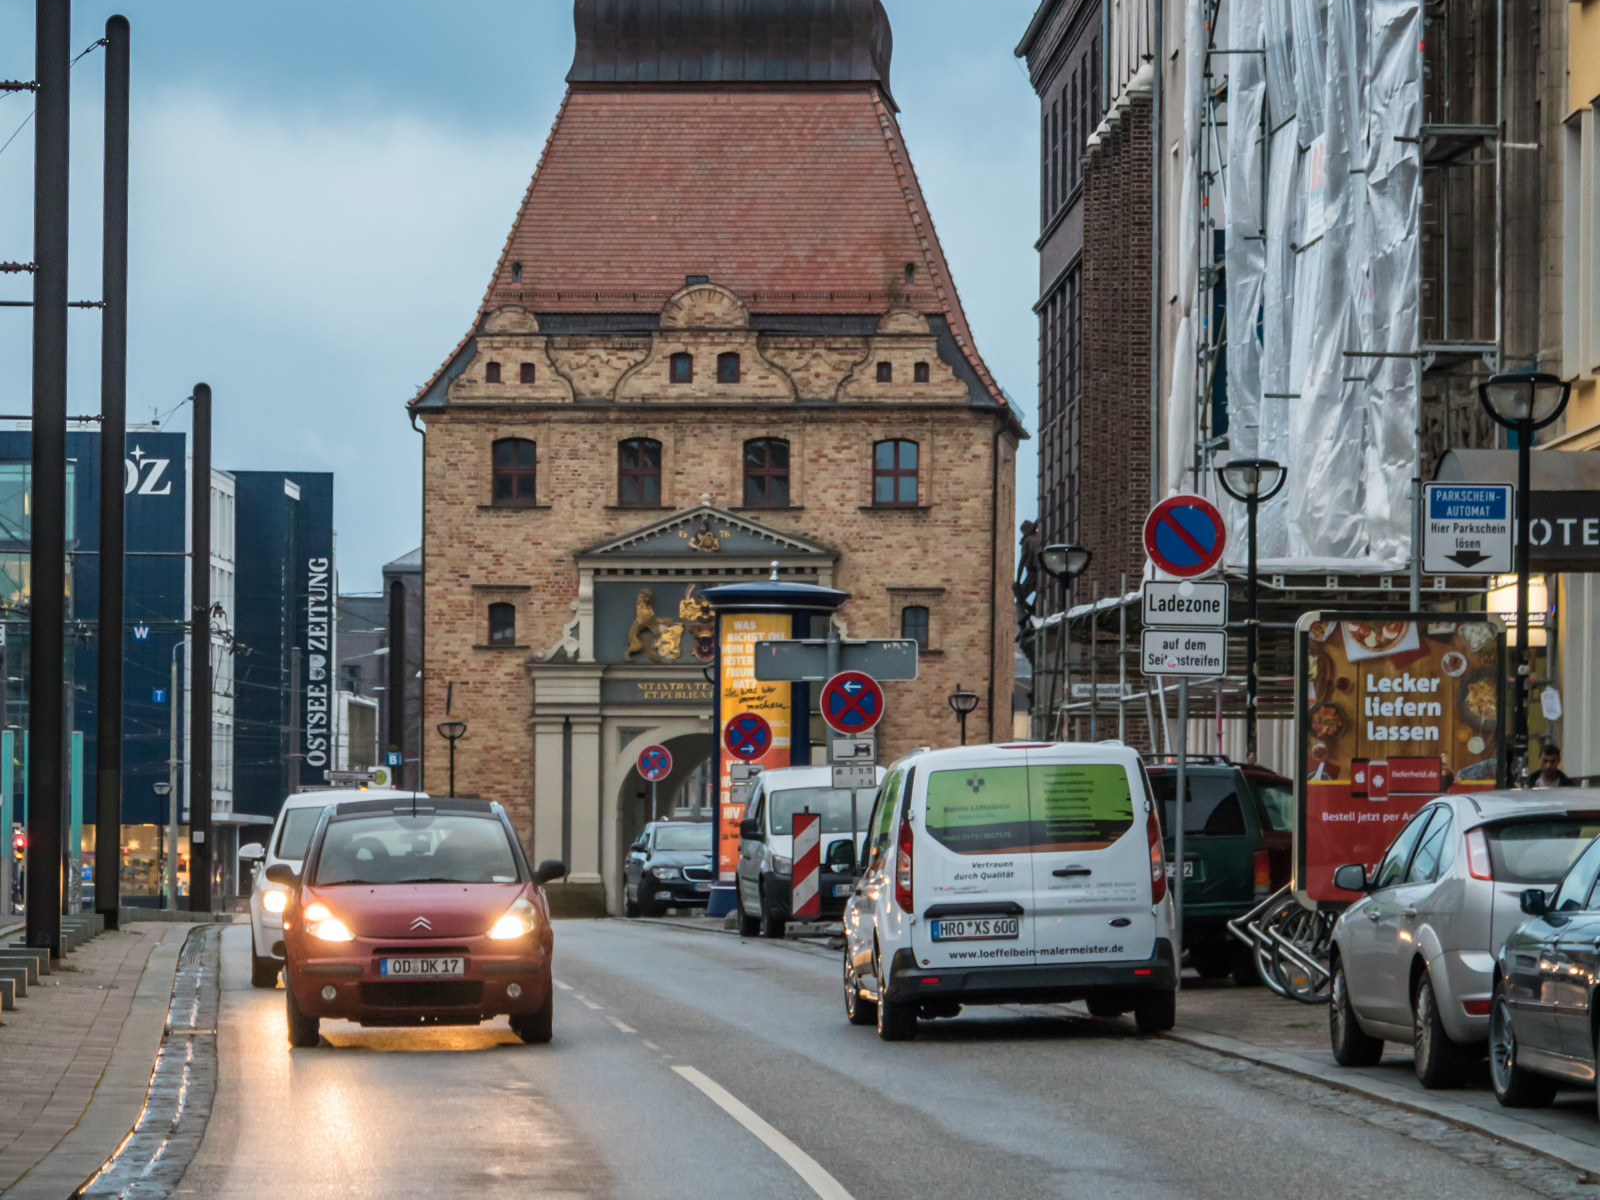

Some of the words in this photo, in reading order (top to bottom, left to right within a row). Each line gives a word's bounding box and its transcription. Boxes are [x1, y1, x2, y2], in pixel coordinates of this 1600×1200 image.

[1436, 490, 1502, 502] PARKSCHEIN-
[1446, 505, 1491, 517] AUTOMAT
[1431, 522, 1450, 533] Hier
[1453, 522, 1506, 534] Parkschein
[1455, 537, 1481, 549] lösen
[307, 557, 329, 651] ZEITUNG
[1149, 593, 1220, 613] Ladezone
[733, 620, 757, 631] WAS
[133, 626, 149, 639] W
[727, 632, 766, 642] MACHST
[1162, 638, 1180, 650] auf
[1184, 638, 1206, 650] dem
[1148, 652, 1220, 667] Seinstreifen
[726, 667, 755, 678] FREUN
[1366, 672, 1441, 693] Lecker
[1364, 696, 1442, 717] liefern
[306, 684, 328, 767] OSTSEE
[1367, 720, 1440, 741] lassen
[723, 806, 740, 819] HIV
[1321, 811, 1356, 822] Bestell
[1357, 811, 1380, 824] jetzt
[1382, 813, 1400, 824] per
[972, 861, 1014, 869] Vertrauen
[953, 872, 978, 881] durch
[980, 871, 1014, 880] Qualität
[940, 921, 964, 936] HRO
[974, 920, 990, 935] XS
[993, 919, 1016, 934] 600
[949, 943, 1124, 960] www.loeffelbein-malermeister.de
[393, 960, 411, 973] OD
[420, 960, 438, 973] DK
[441, 960, 459, 973] 17
